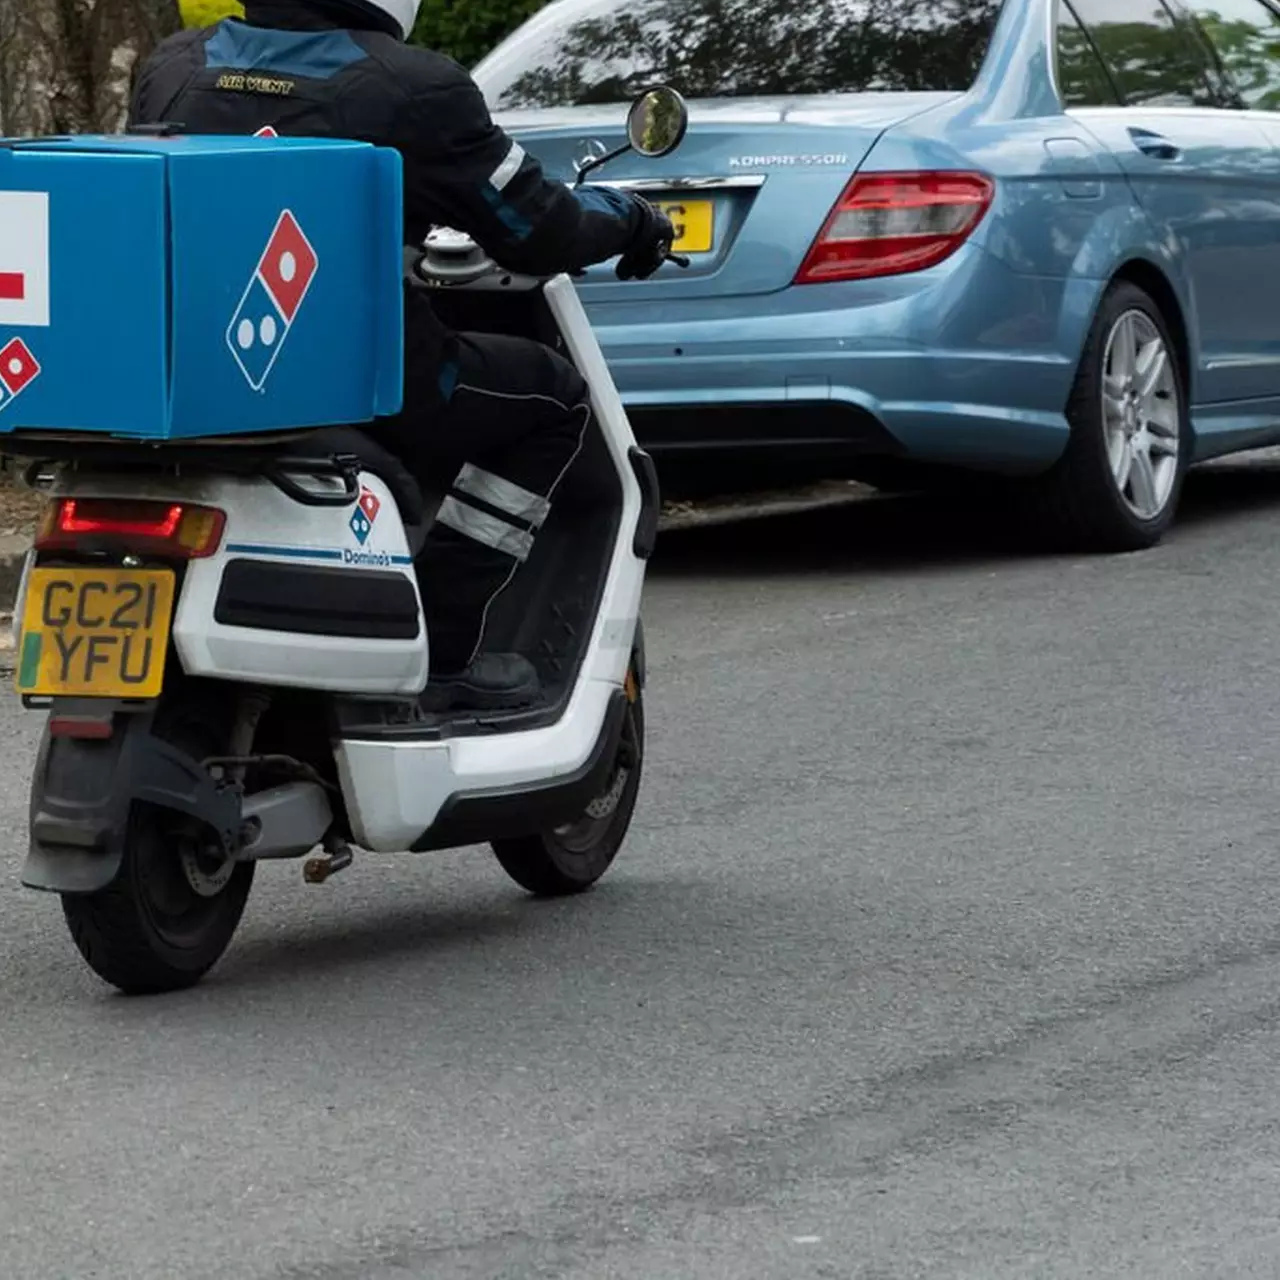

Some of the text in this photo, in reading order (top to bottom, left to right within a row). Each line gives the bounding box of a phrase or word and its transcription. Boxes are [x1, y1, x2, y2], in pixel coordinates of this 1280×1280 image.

[216, 75, 295, 95] AIR VENT
[729, 154, 847, 166] KOMPRESSOR
[343, 548, 391, 567] Domino's
[42, 580, 157, 629] GC21
[53, 634, 153, 683] YFU
